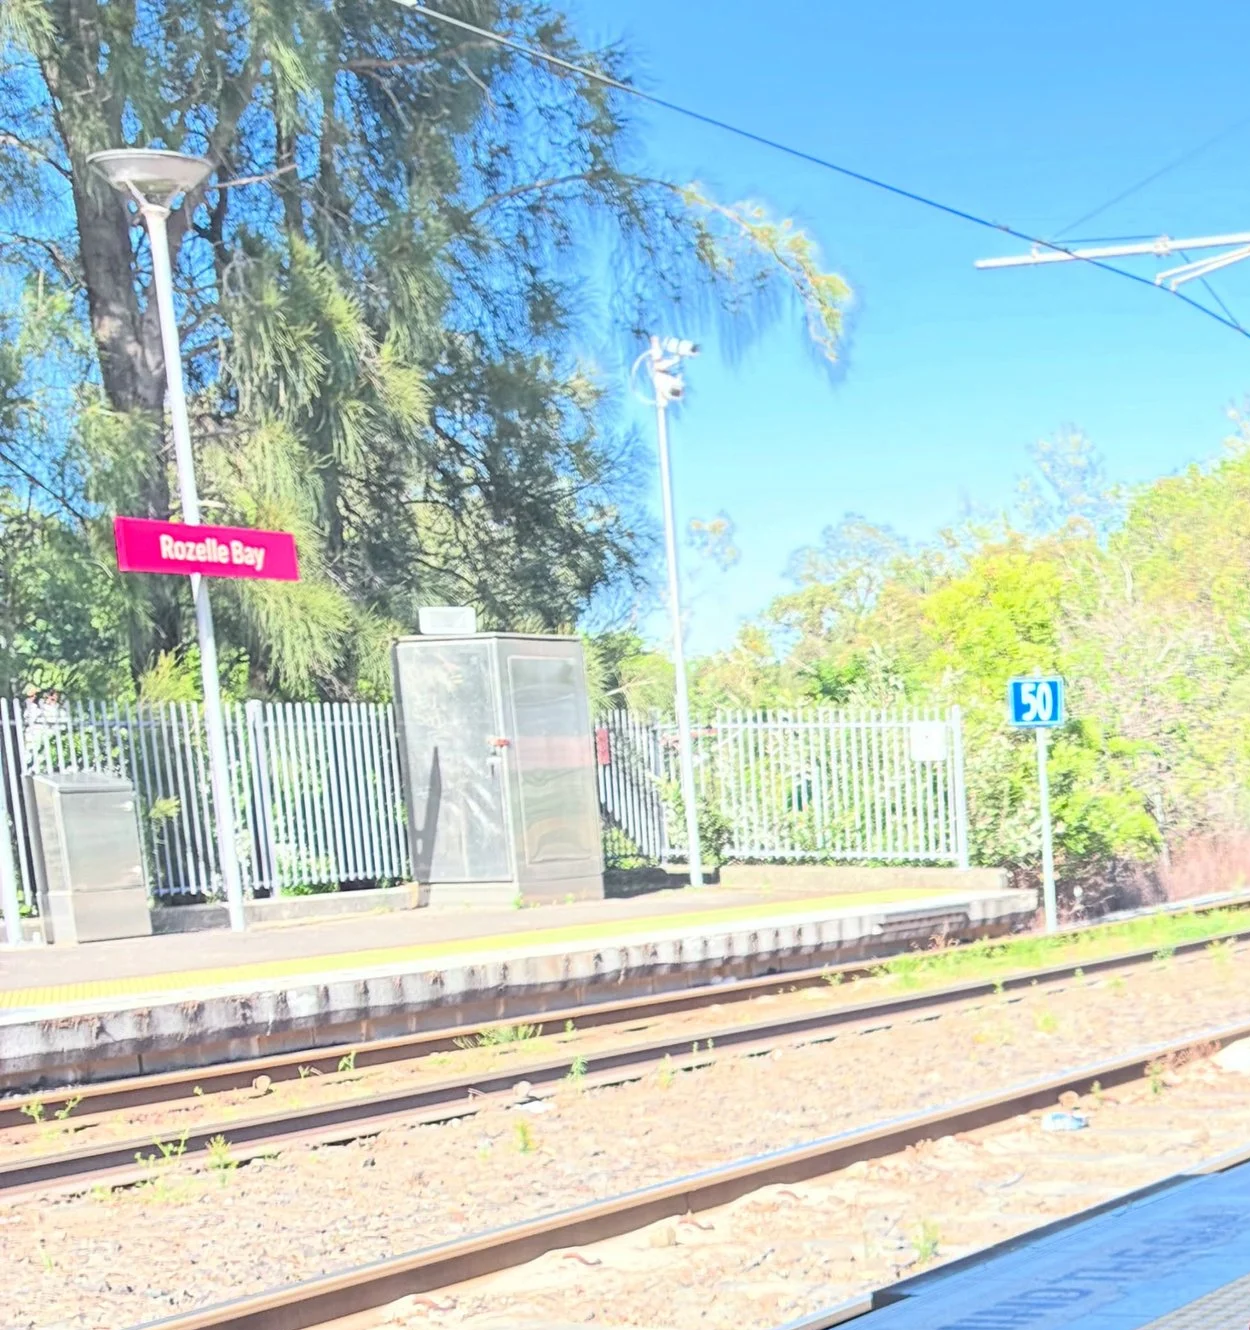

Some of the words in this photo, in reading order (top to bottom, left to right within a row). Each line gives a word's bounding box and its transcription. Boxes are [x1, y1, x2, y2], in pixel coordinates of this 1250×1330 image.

[159, 533, 229, 564] Rozelle
[229, 539, 265, 571] Bay
[1021, 682, 1053, 721] 50
